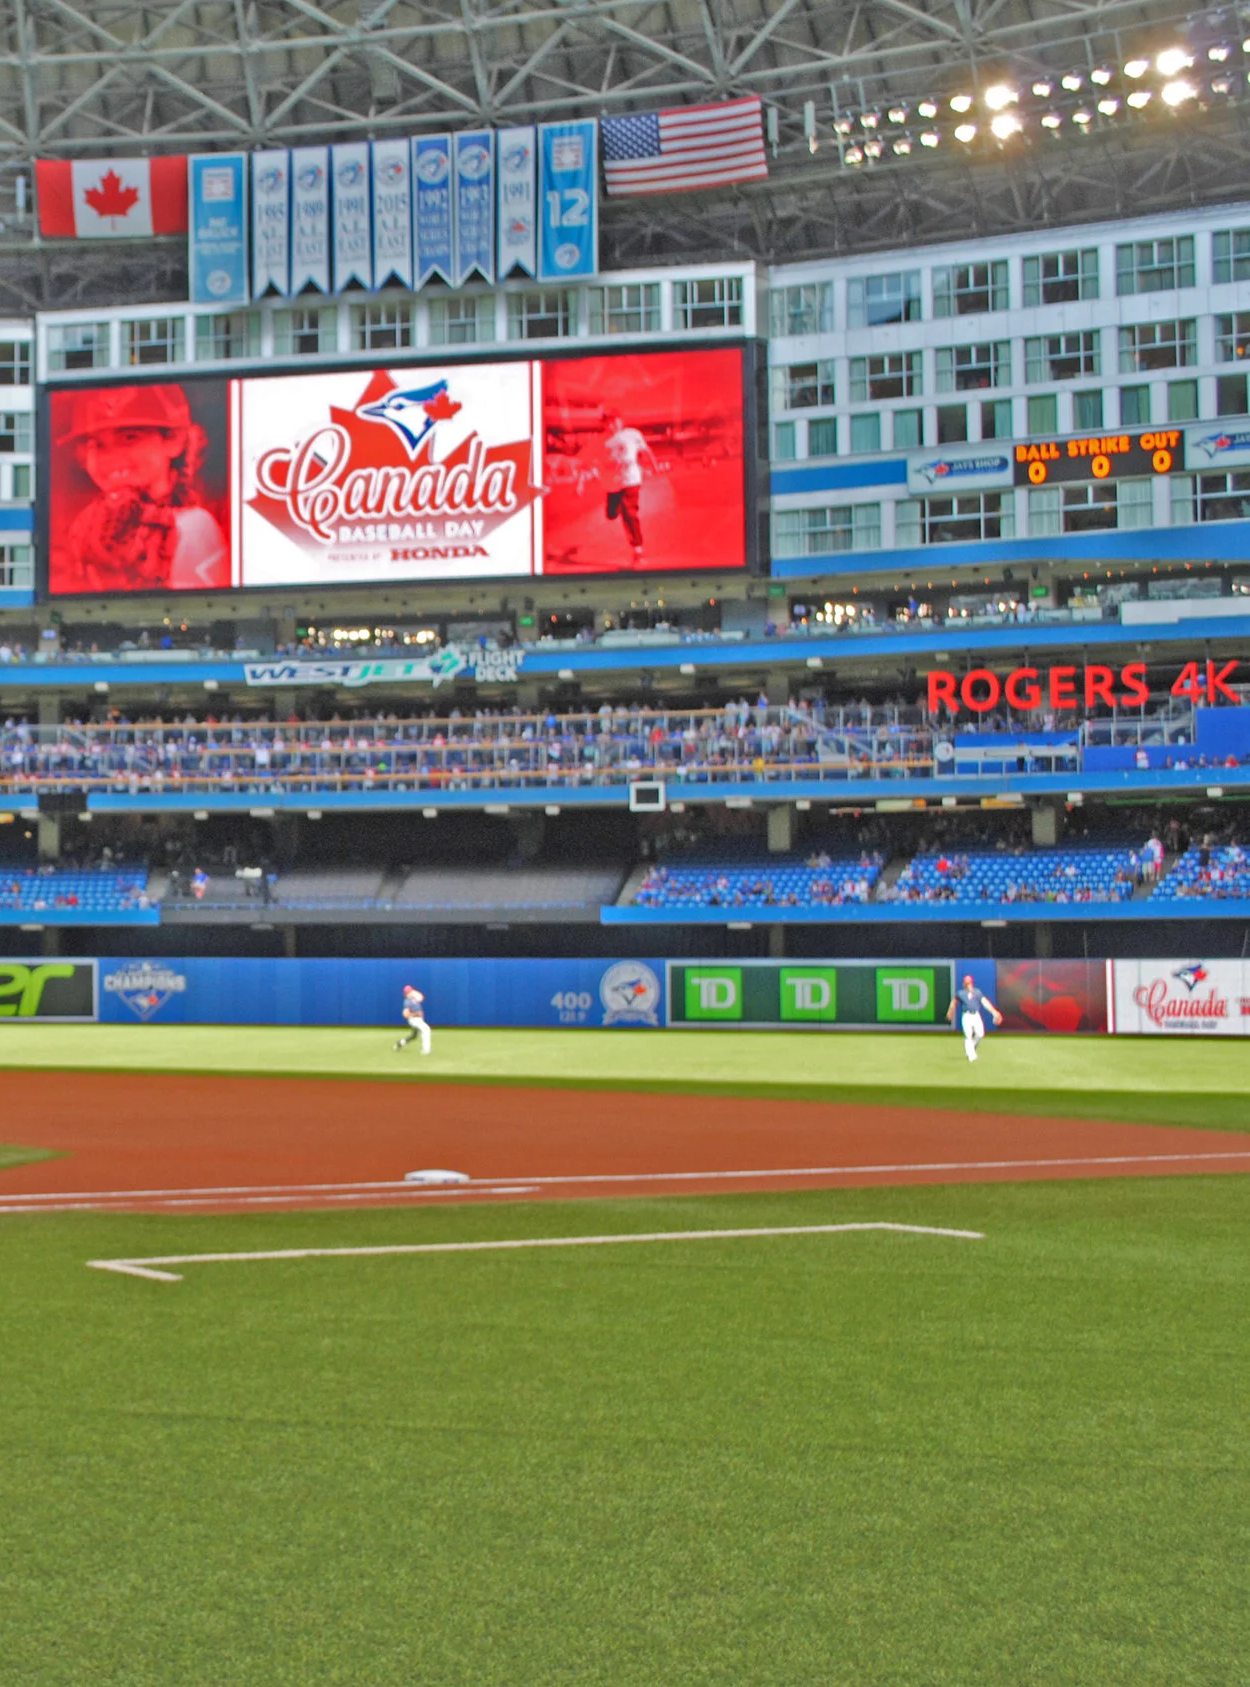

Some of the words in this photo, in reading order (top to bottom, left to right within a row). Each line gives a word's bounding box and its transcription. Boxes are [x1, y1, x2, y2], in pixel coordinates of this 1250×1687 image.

[547, 187, 590, 229] 12
[1015, 442, 1061, 462] BALL
[1067, 434, 1131, 458] STRIKE
[1140, 430, 1181, 450] OUT
[257, 421, 518, 545] Canada
[339, 523, 436, 542] BASEBALL
[445, 520, 484, 537] DAY
[390, 545, 489, 561] HONDA
[469, 650, 526, 667] FLIGHT
[475, 666, 519, 682] DECK
[927, 662, 1150, 713] ROGERS
[1170, 659, 1243, 704] 4K
[103, 975, 186, 992] CHAMPIONS
[691, 977, 736, 1009] TD
[786, 977, 831, 1009] TD
[882, 977, 928, 1011] TD
[550, 991, 593, 1010] 400
[1134, 979, 1228, 1028] Canada
